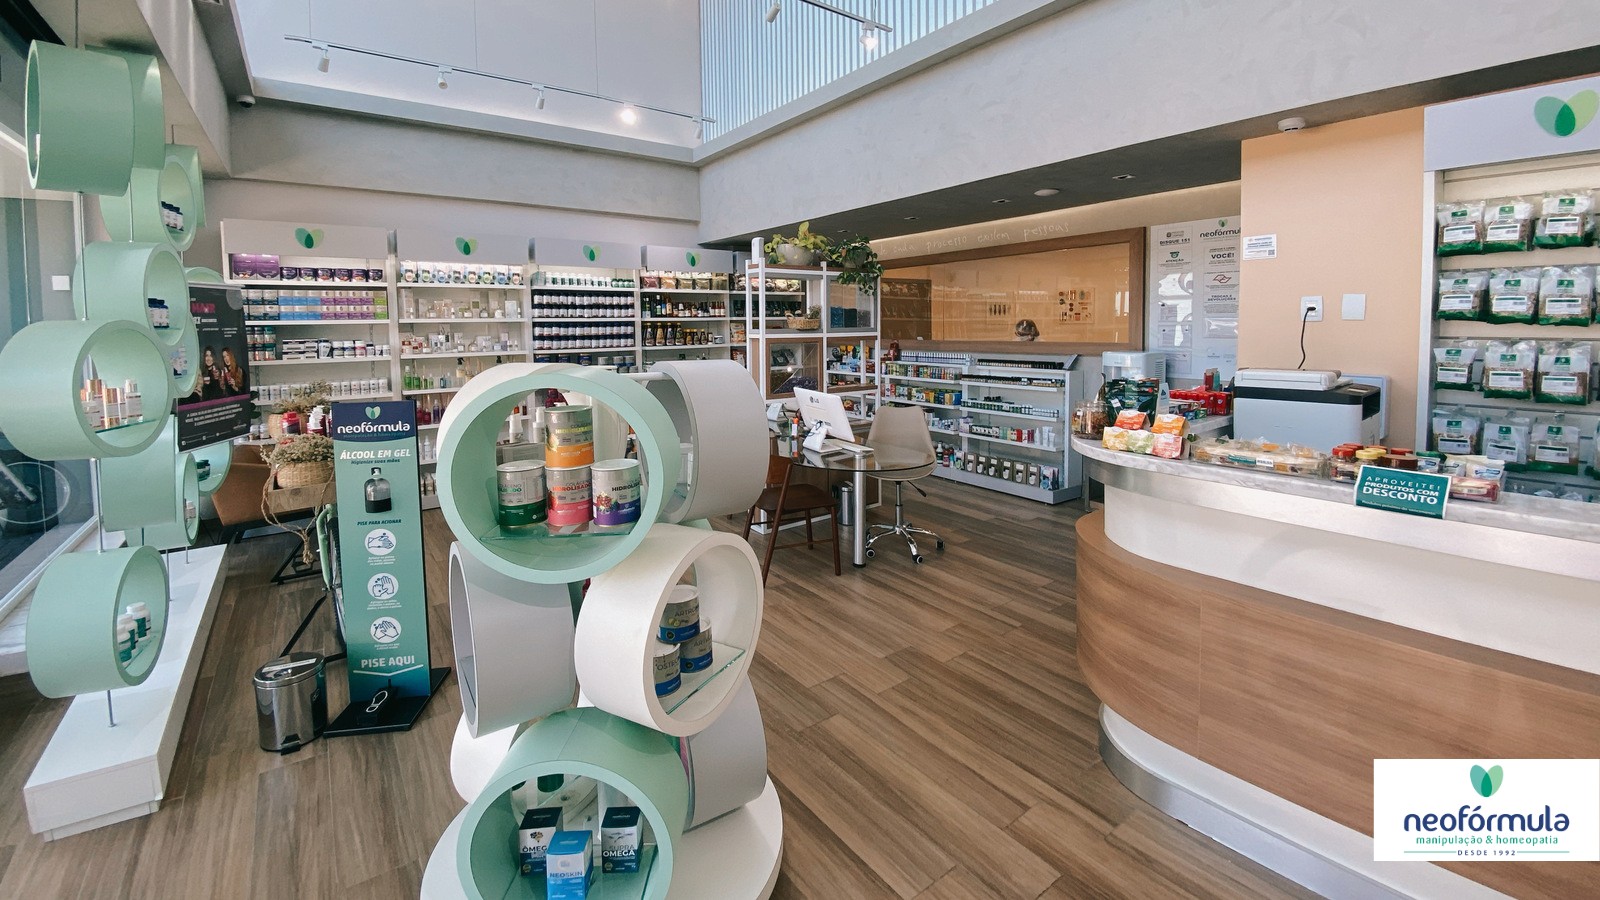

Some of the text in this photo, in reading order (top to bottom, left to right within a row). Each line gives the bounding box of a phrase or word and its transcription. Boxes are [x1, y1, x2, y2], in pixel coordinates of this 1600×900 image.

[1023, 222, 1069, 241] pessoas
[337, 420, 411, 434] neofórmula
[340, 448, 411, 460] ÁLCOOL EM GEL
[1364, 481, 1439, 497] PRODUTOS COM
[1365, 476, 1441, 490] APROVEITE!
[1362, 486, 1438, 505] DESCONTO
[361, 655, 415, 668] PISE AQUI
[522, 845, 547, 853] ÔMEG
